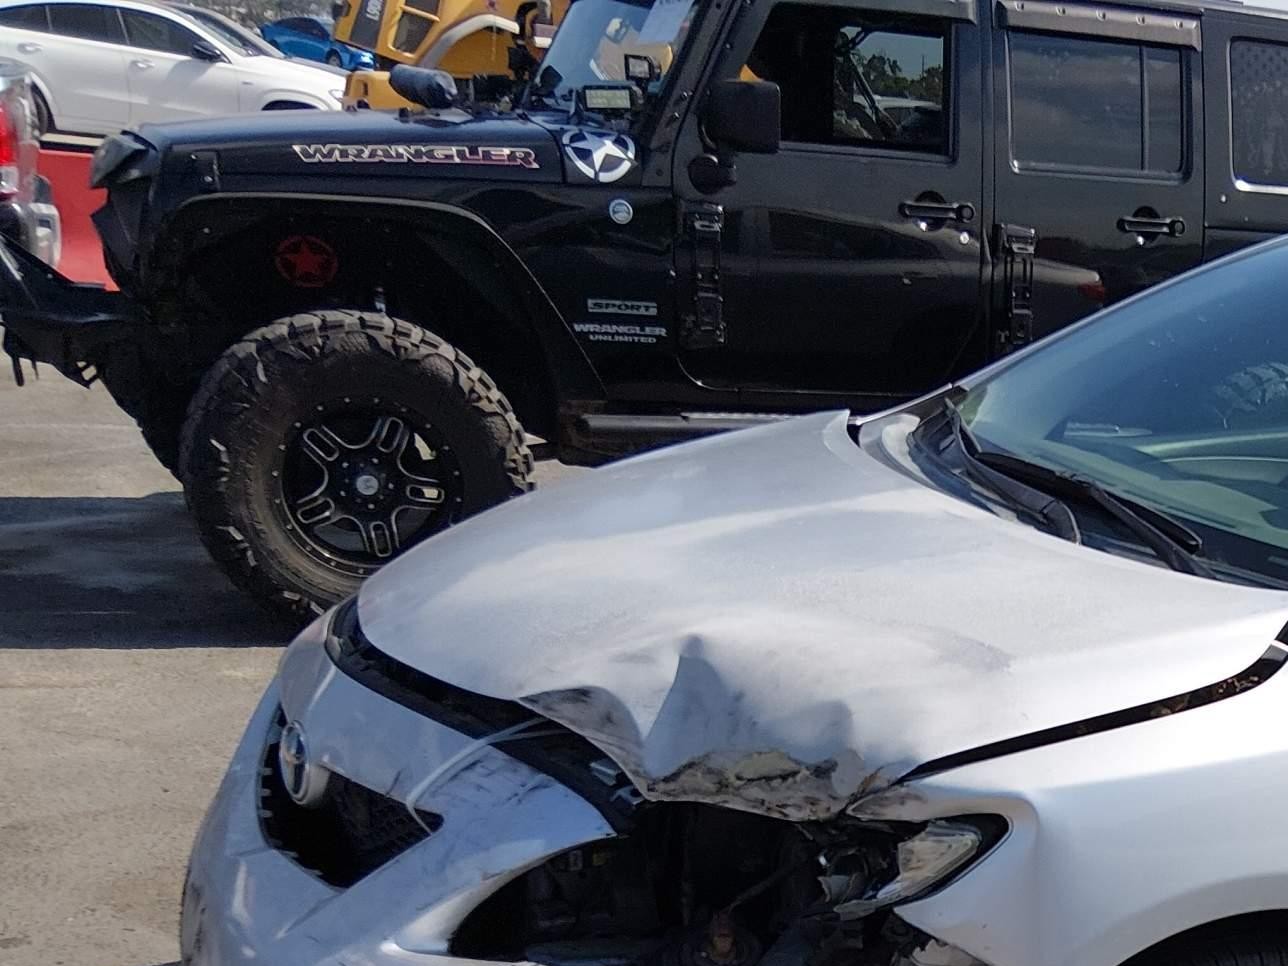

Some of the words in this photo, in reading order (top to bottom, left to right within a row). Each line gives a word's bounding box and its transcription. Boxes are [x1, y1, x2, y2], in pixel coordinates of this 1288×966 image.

[292, 144, 540, 169] WRANGLER
[591, 302, 657, 313] SPORT
[574, 323, 667, 336] WRANGLER
[589, 334, 657, 344] UNLIMITED
